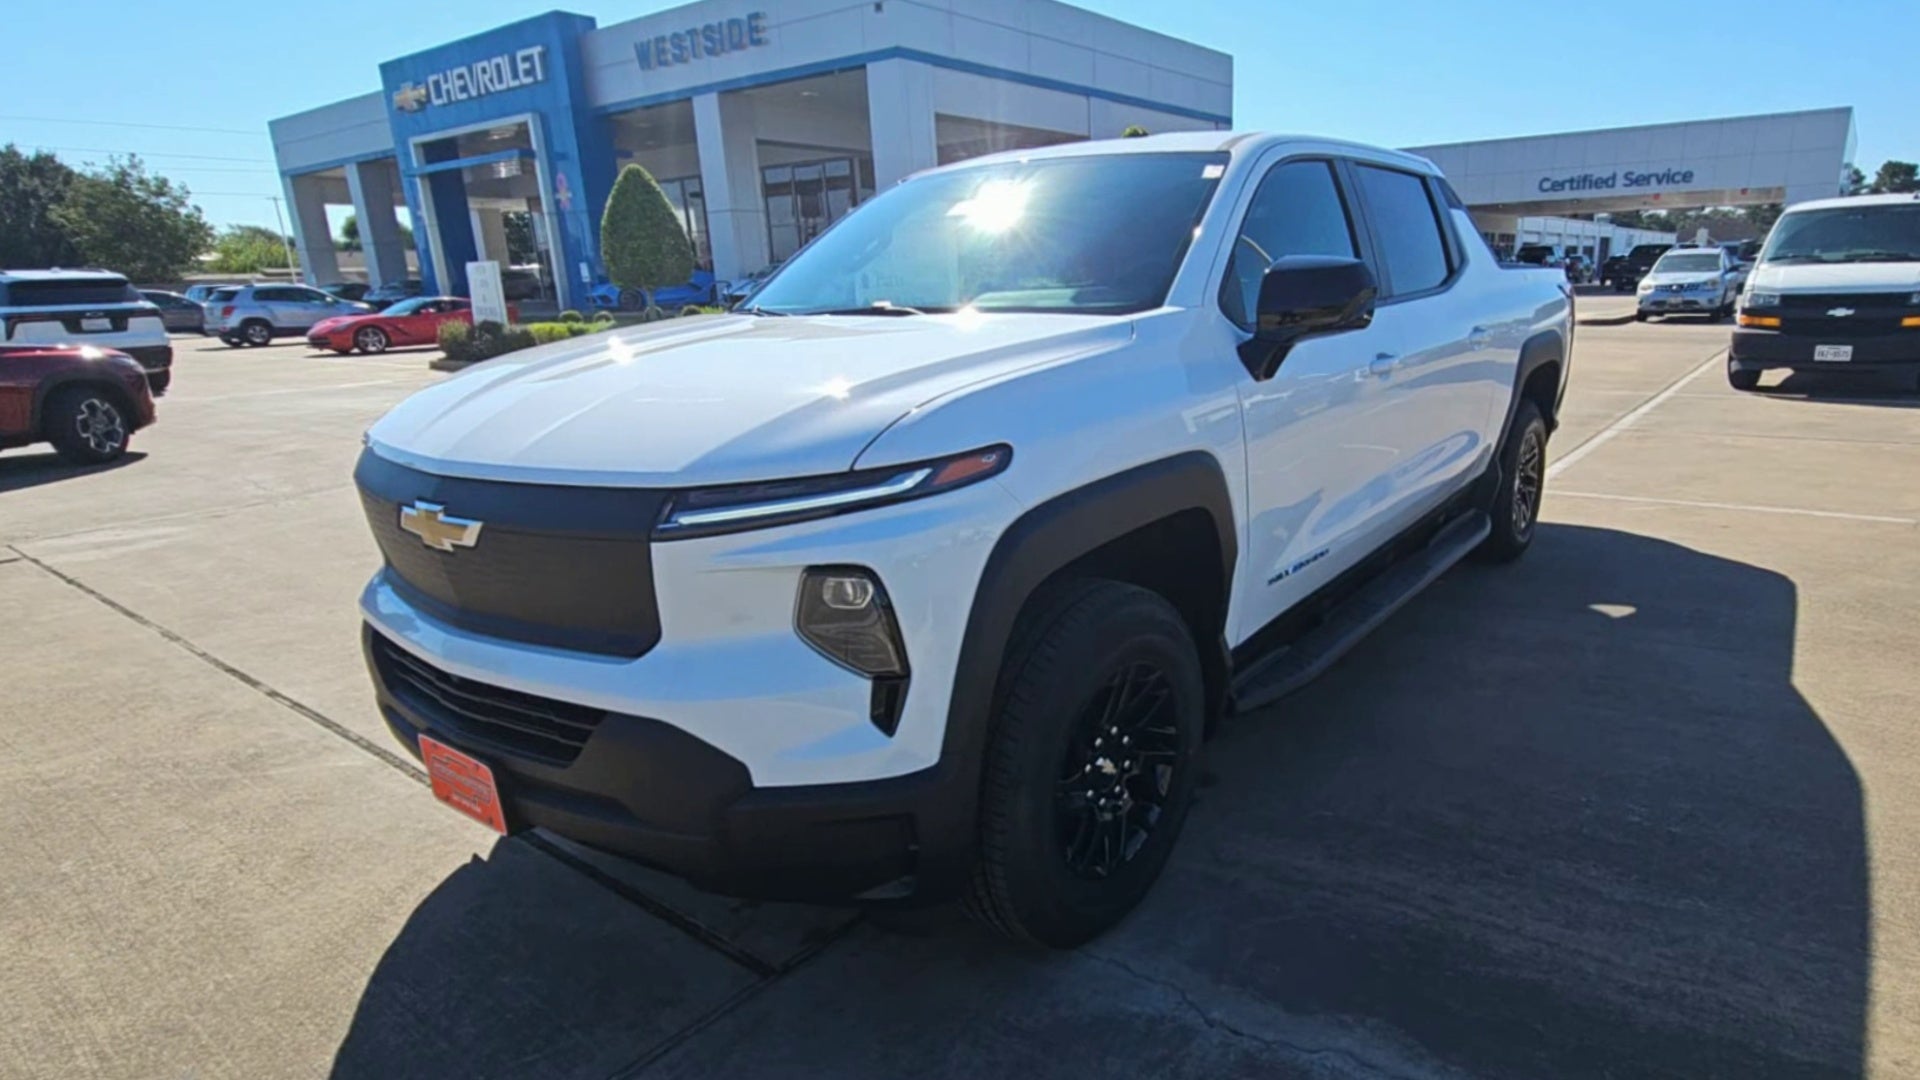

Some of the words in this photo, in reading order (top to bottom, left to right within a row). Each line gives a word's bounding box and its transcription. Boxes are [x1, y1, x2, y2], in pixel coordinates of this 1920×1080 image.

[634, 12, 767, 70] WESTSIDE
[427, 45, 544, 106] CHEVROLET
[1538, 172, 1617, 193] Certified
[1622, 168, 1694, 188] Service
